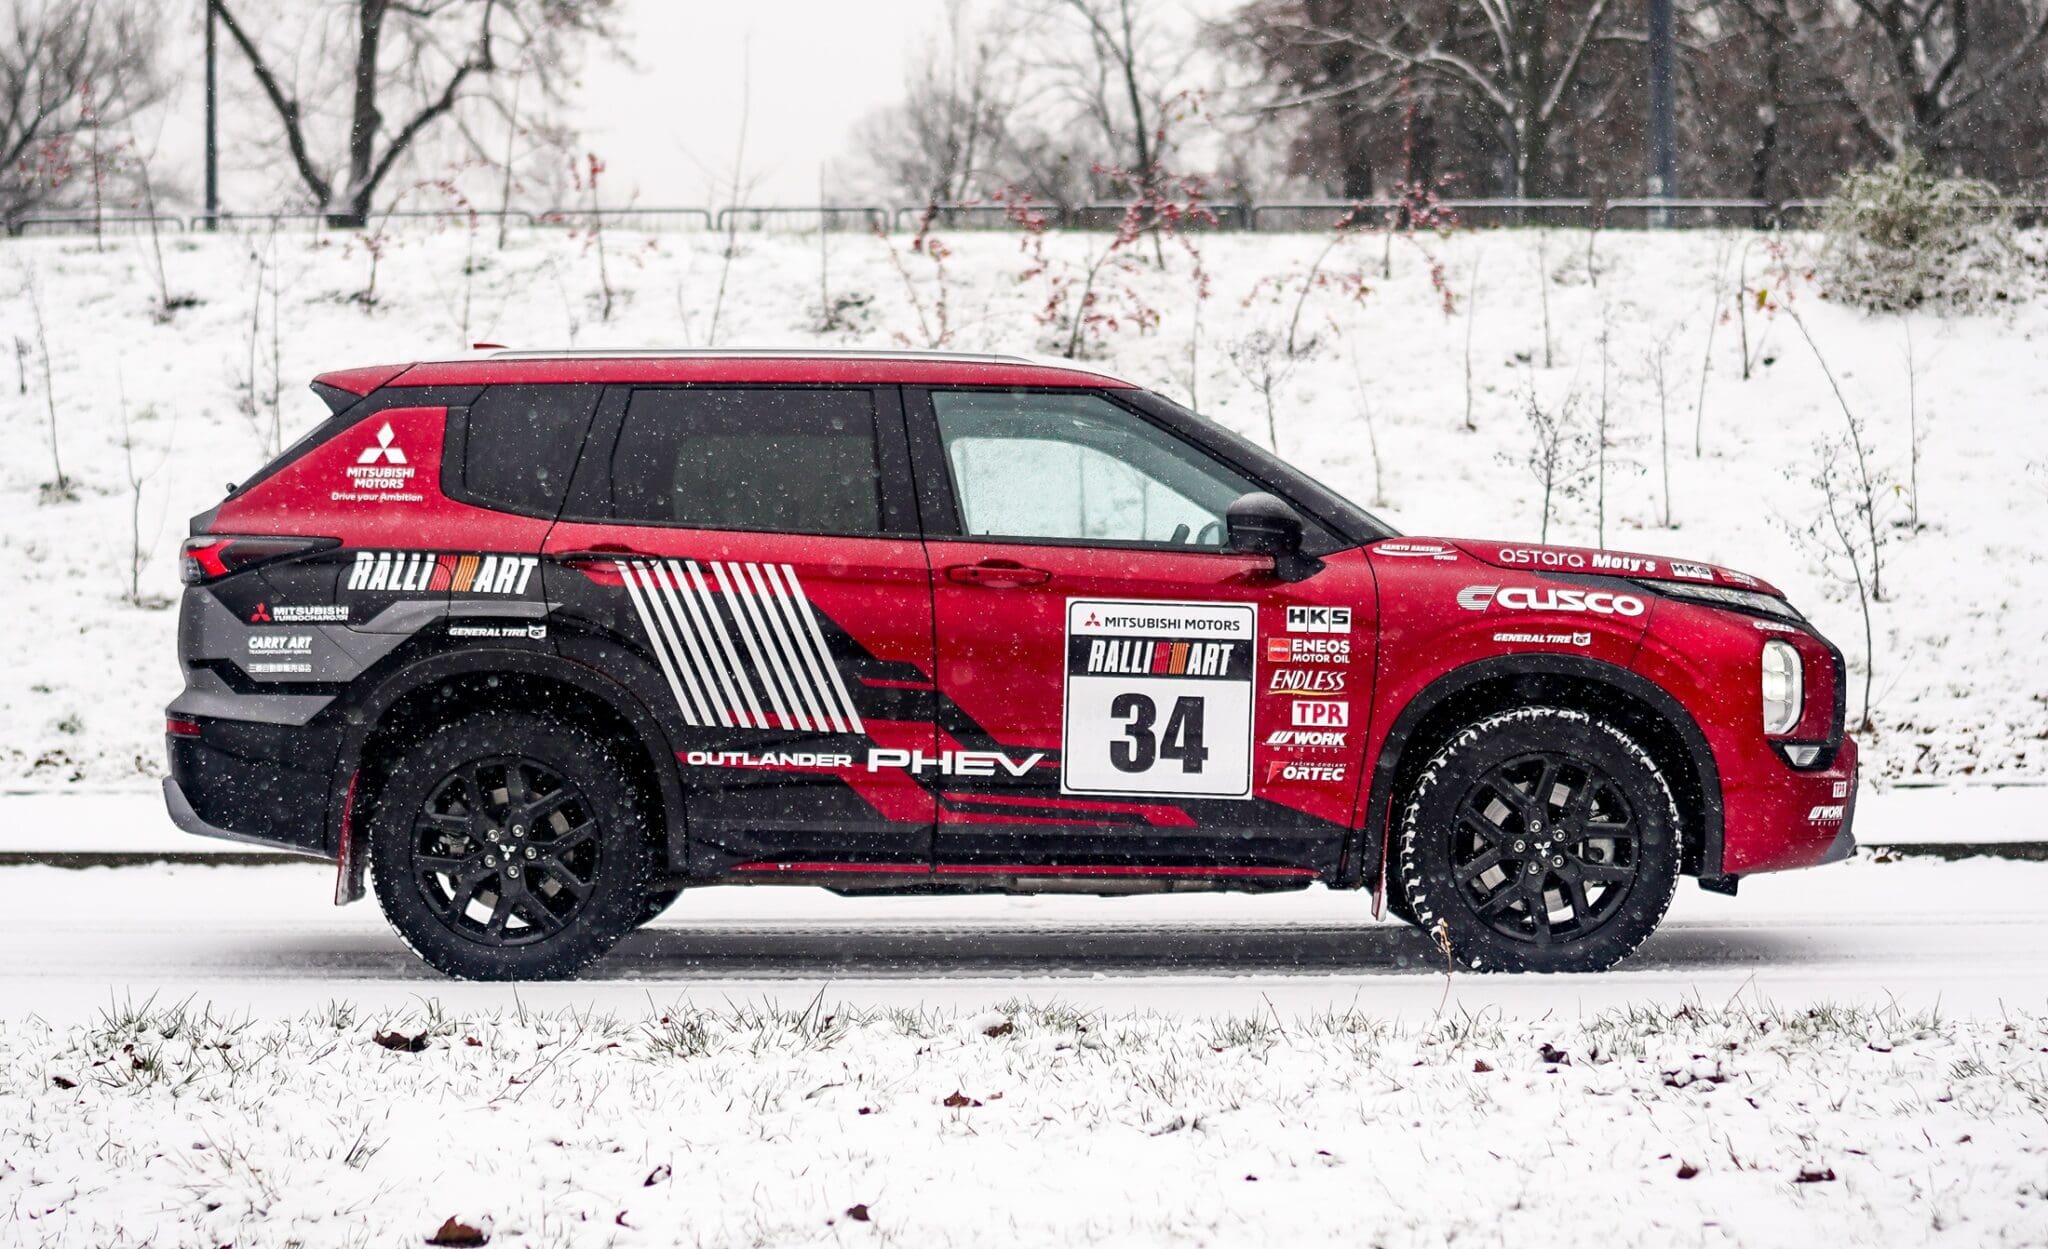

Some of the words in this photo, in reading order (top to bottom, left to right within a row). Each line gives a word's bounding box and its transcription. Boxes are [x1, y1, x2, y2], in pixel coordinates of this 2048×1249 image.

[346, 467, 415, 478] MITSUBISHI
[354, 478, 404, 489] MOTORS
[331, 492, 356, 501] Drive
[357, 493, 378, 502] your
[380, 492, 423, 502] Ambition
[1592, 553, 1656, 572] Moty's
[472, 555, 539, 595] ART
[1496, 587, 1645, 617] CUSCO
[273, 606, 349, 615] MITSUBISHI
[1288, 608, 1350, 625] HKS
[1105, 616, 1181, 629] MITSUBISHI
[1185, 618, 1240, 631] MOTORS
[449, 626, 500, 637] GENERAL
[501, 627, 528, 638] TIRE
[1493, 633, 1545, 643] GENERAL
[1546, 634, 1573, 644] TIRE
[248, 636, 287, 649] CARRY
[288, 636, 313, 649] ART
[1292, 638, 1350, 654] ENEOS
[1186, 643, 1235, 676] ART
[1292, 653, 1330, 663] MOTOR
[1332, 654, 1350, 664] OIL
[1270, 669, 1347, 691] ENDLESS
[1296, 703, 1343, 725] TPR
[1109, 692, 1209, 774] 34
[1294, 731, 1347, 746] WORK
[687, 749, 852, 768] OUTLANDER
[867, 748, 1045, 777] PHEV
